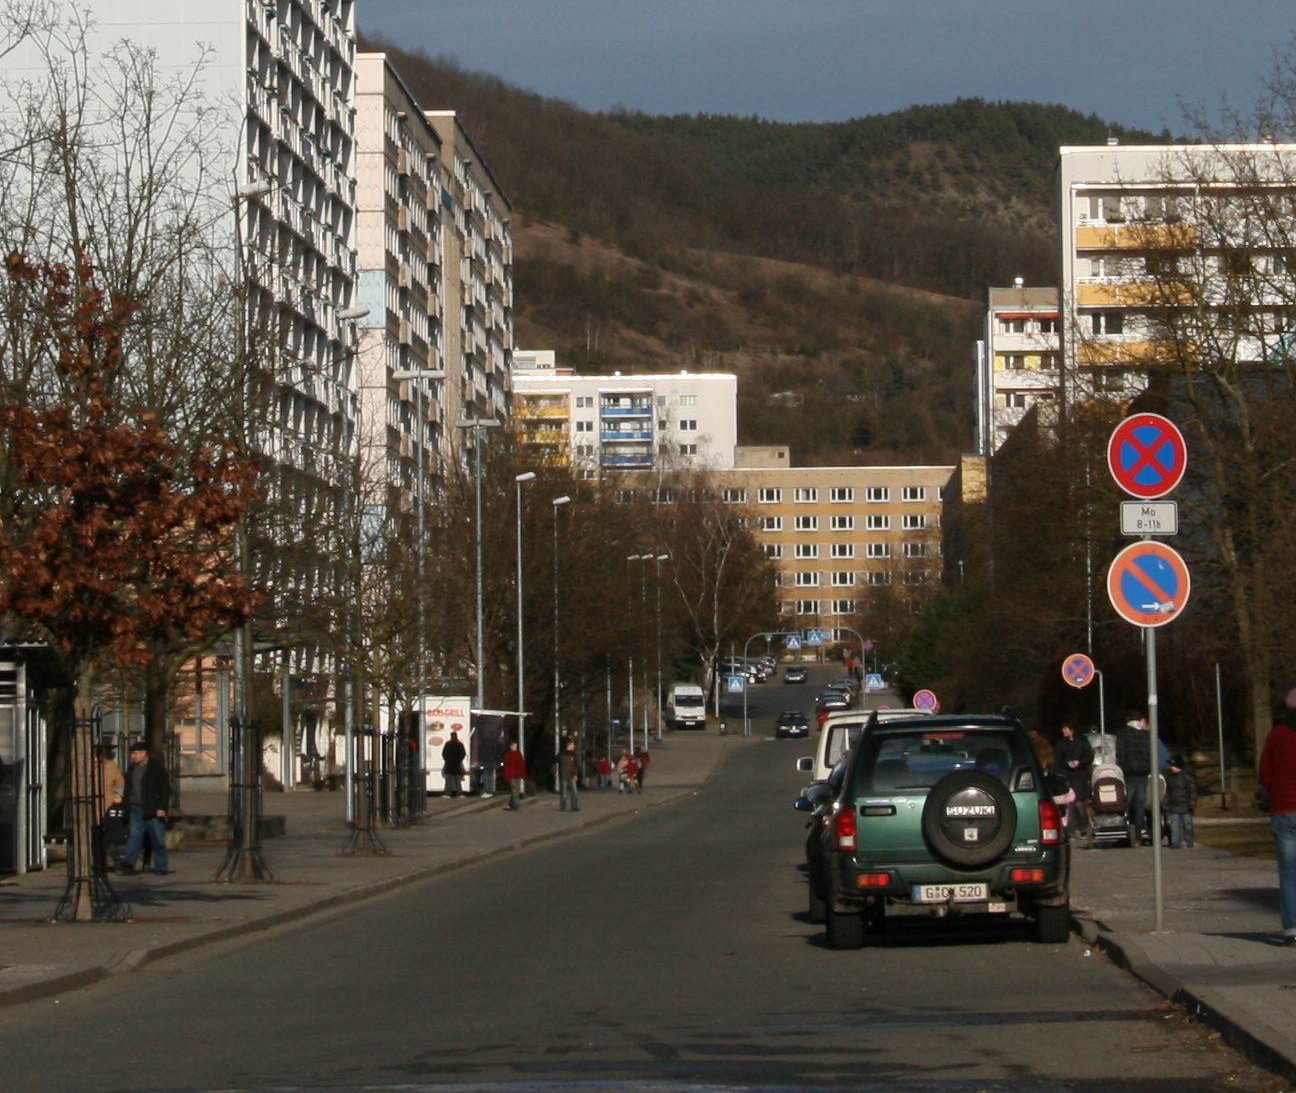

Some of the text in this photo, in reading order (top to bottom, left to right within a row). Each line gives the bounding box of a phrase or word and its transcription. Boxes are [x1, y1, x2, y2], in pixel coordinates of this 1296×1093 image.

[1141, 507, 1156, 517] Mo
[1136, 519, 1161, 529] 8-11h
[945, 805, 996, 817] SUZUKI
[959, 885, 982, 898] 520
